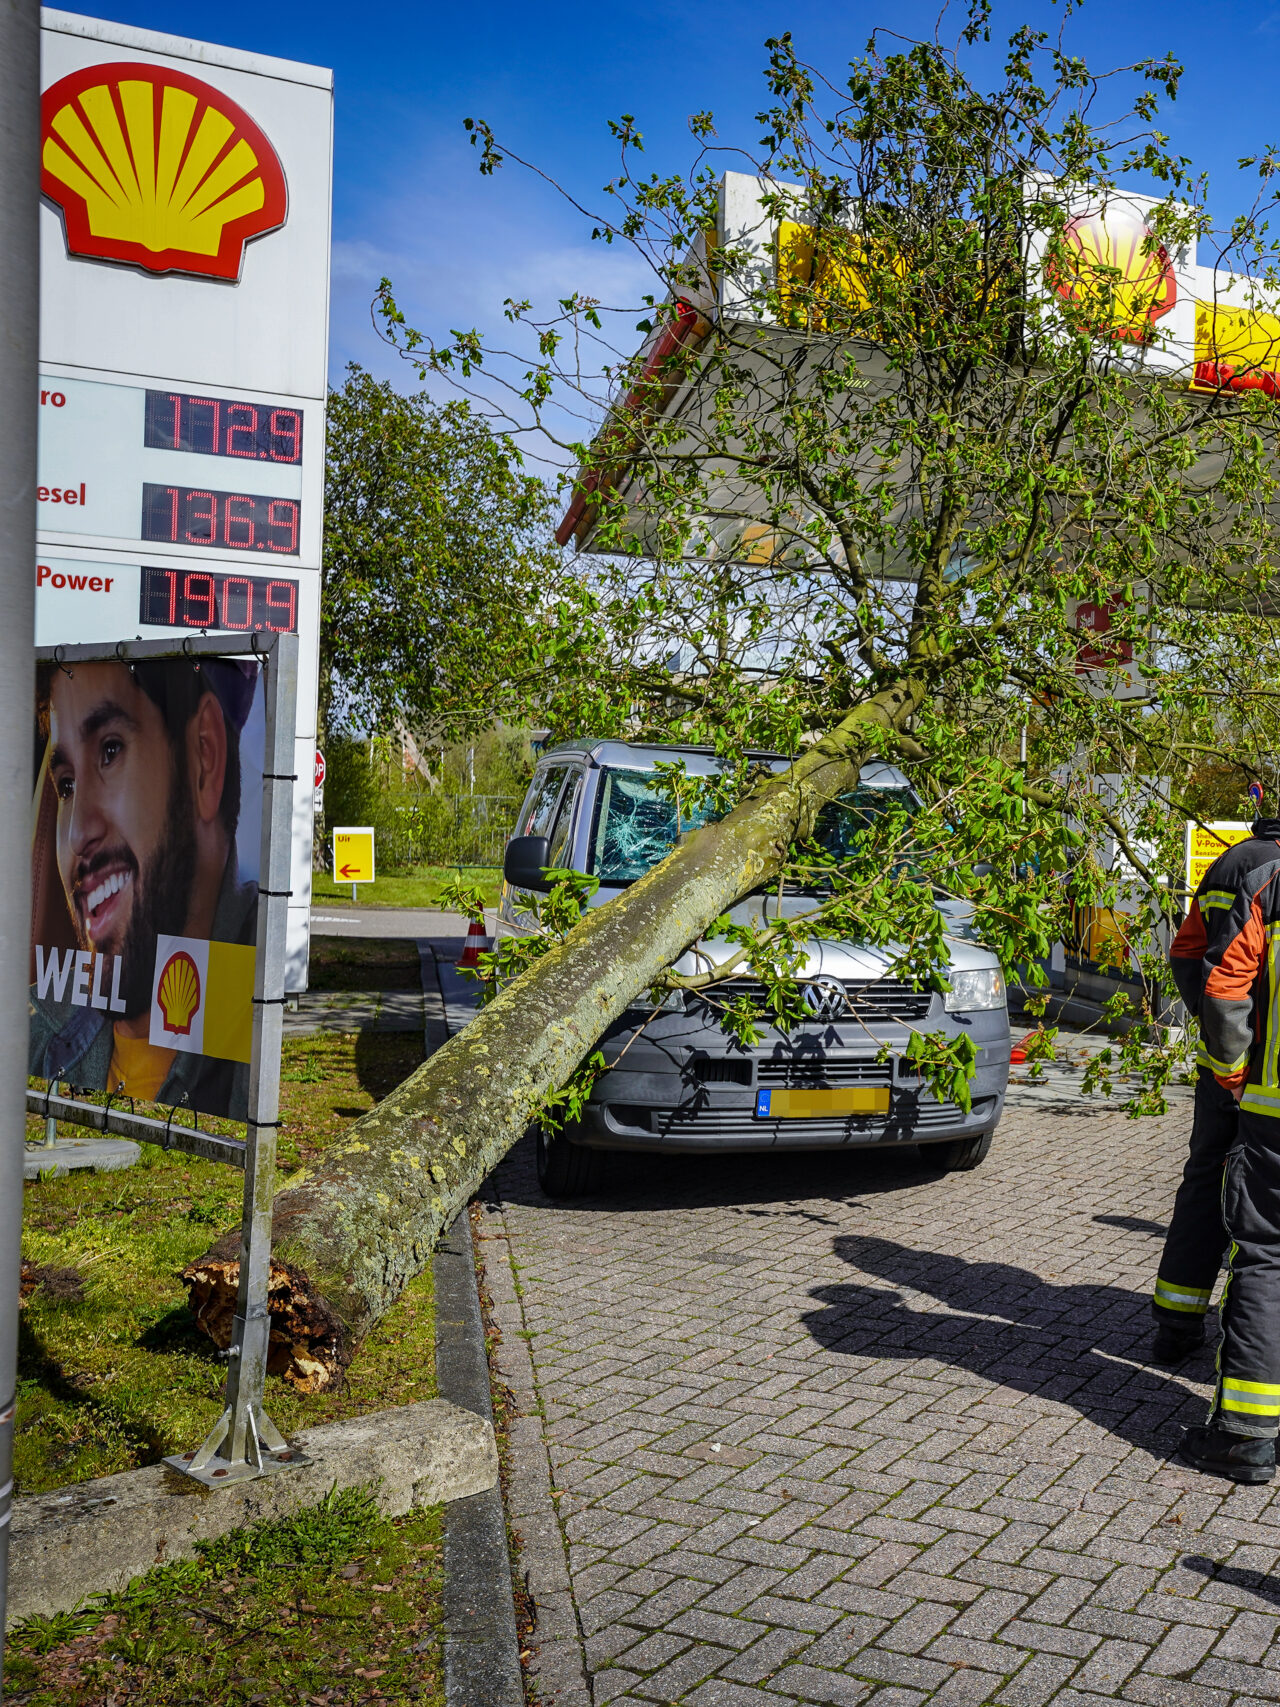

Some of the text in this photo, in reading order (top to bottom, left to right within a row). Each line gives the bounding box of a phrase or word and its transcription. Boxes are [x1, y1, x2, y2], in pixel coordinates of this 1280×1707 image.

[169, 395, 301, 462] 172.9
[167, 488, 298, 552] 136.9
[36, 565, 114, 593] Power
[165, 571, 296, 633] 190.9
[35, 944, 126, 1013] WELL
